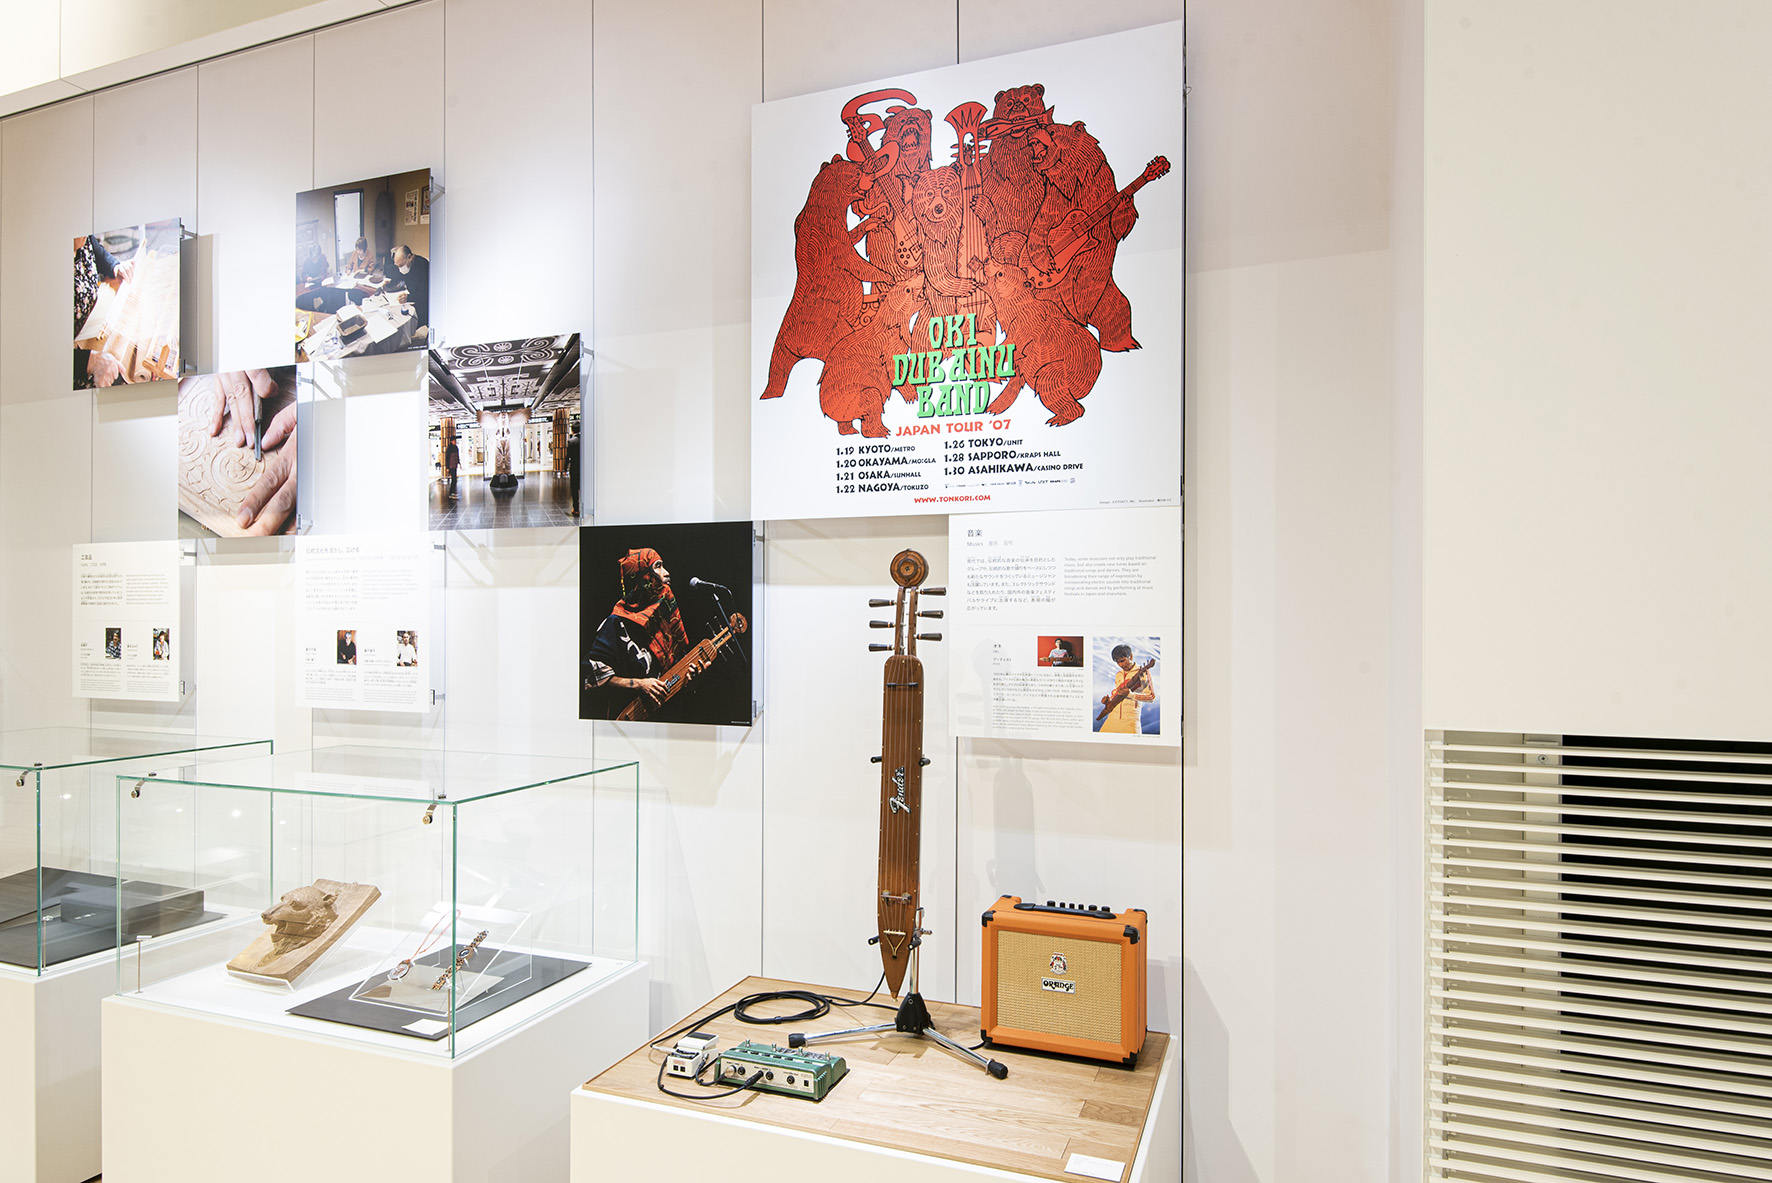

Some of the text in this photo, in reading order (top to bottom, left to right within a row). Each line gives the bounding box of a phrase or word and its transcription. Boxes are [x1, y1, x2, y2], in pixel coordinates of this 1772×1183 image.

[929, 313, 978, 349] OKI
[892, 344, 1017, 387] DUB AINU
[916, 381, 991, 418] BAND
[895, 419, 1011, 436] JAPAN TOUR '07
[944, 440, 965, 449] 1.26
[836, 446, 854, 455] 1.19
[944, 453, 964, 462] 1.28
[836, 459, 857, 468] 1.20
[944, 465, 965, 475] 1.30
[836, 472, 854, 480] 1.21
[836, 484, 855, 493] 1.22
